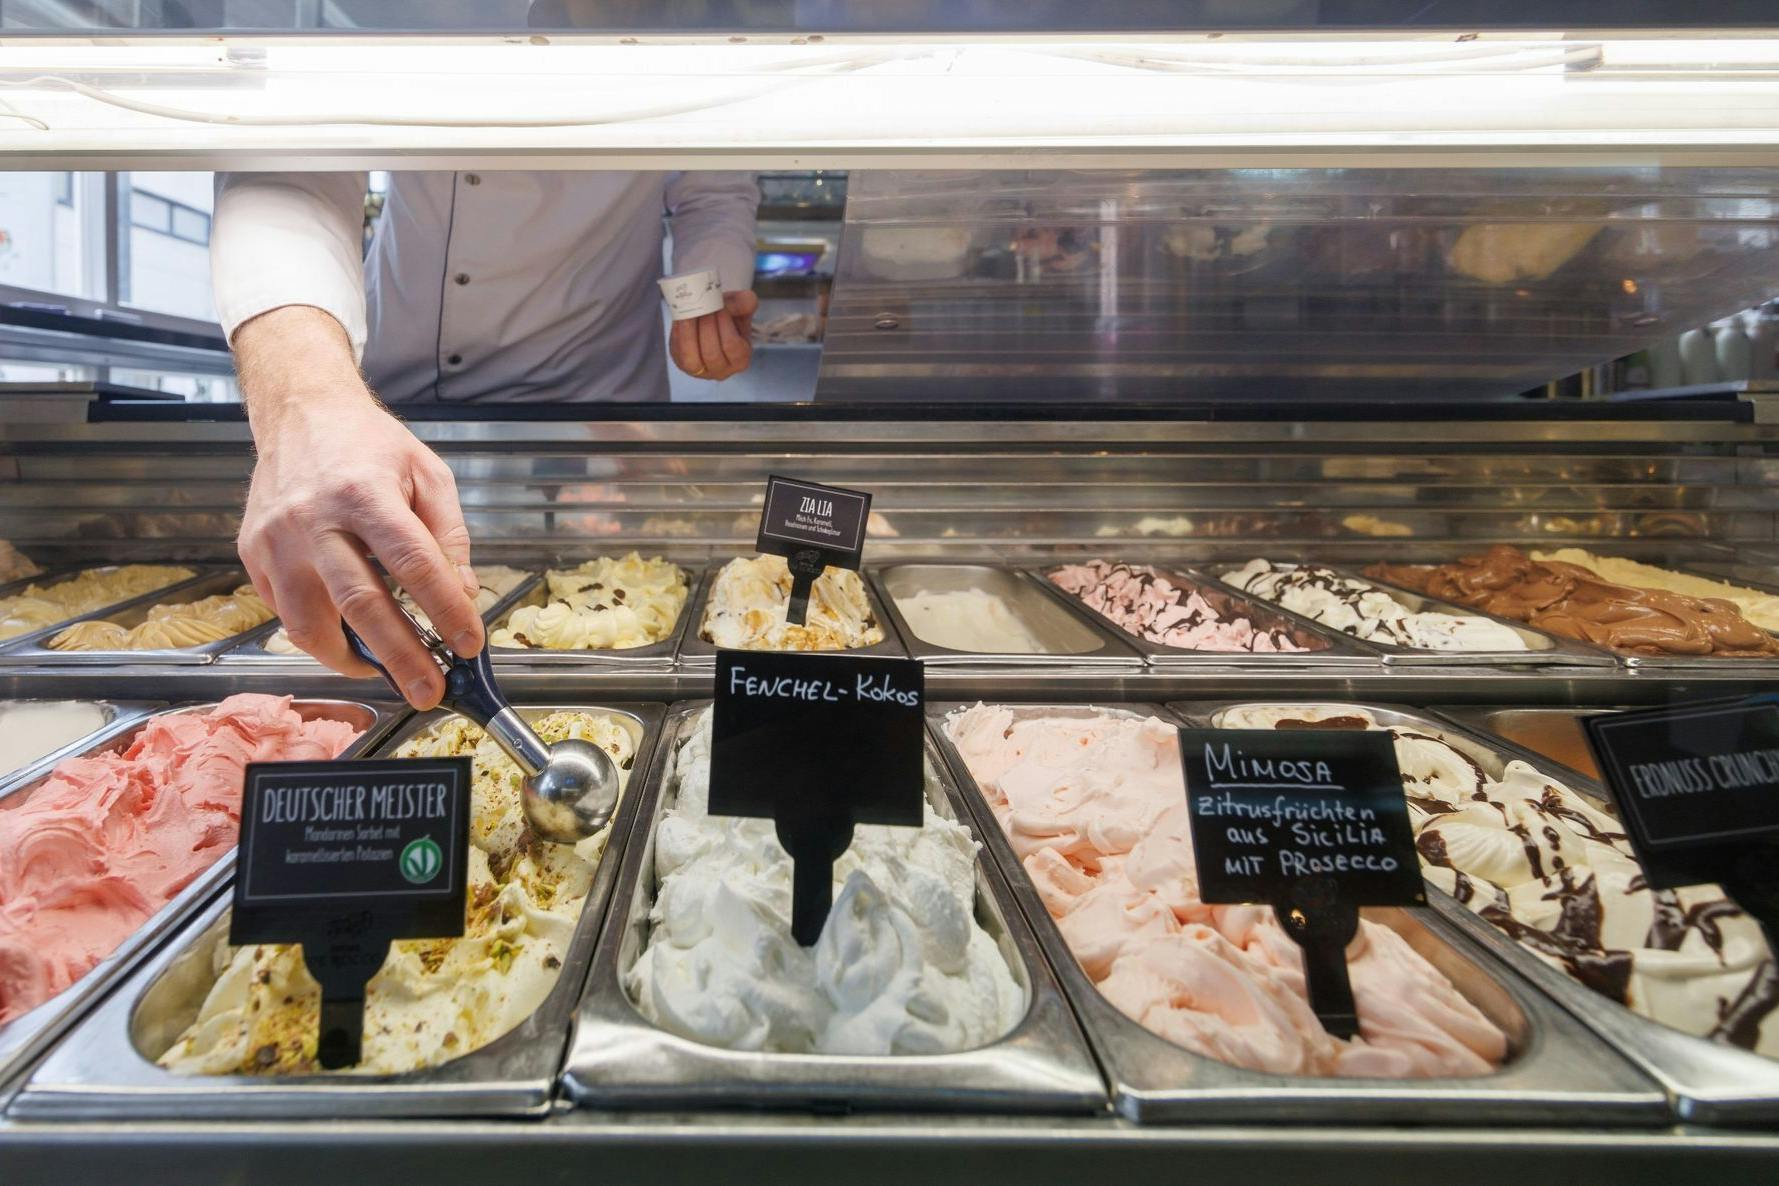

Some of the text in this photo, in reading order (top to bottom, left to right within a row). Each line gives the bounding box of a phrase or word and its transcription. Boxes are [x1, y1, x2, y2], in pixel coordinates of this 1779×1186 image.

[800, 497, 833, 517] ZIA LIA
[1629, 758, 1713, 799] ERDNUSS
[262, 783, 447, 823] DEUTSCHER MEISTER
[304, 823, 401, 842] Mandarinen Sorbet mit
[1226, 827, 1270, 845] aus
[1225, 856, 1265, 875] MIT
